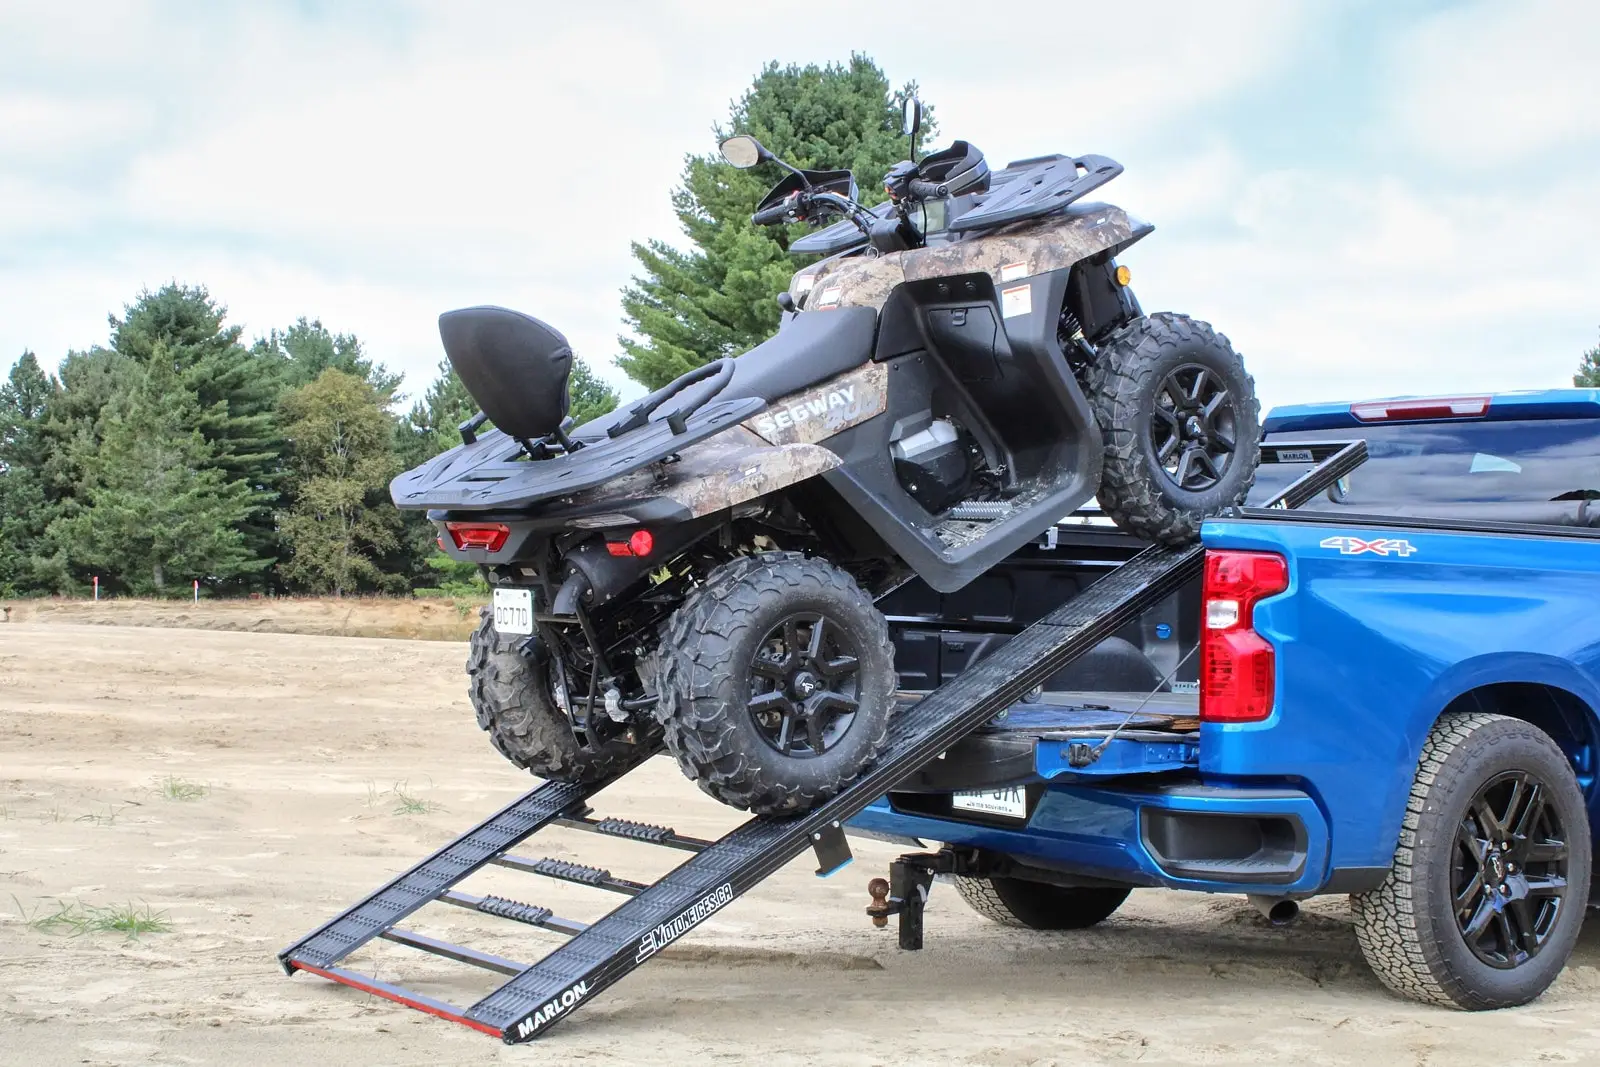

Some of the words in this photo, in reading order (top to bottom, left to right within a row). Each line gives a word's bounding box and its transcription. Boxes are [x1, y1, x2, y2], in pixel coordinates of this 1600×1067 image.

[757, 384, 856, 435] SEGWAY
[1282, 452, 1309, 461] MARLON
[652, 882, 732, 949] MOTONEIGES.CA
[517, 980, 588, 1039] MARLON
